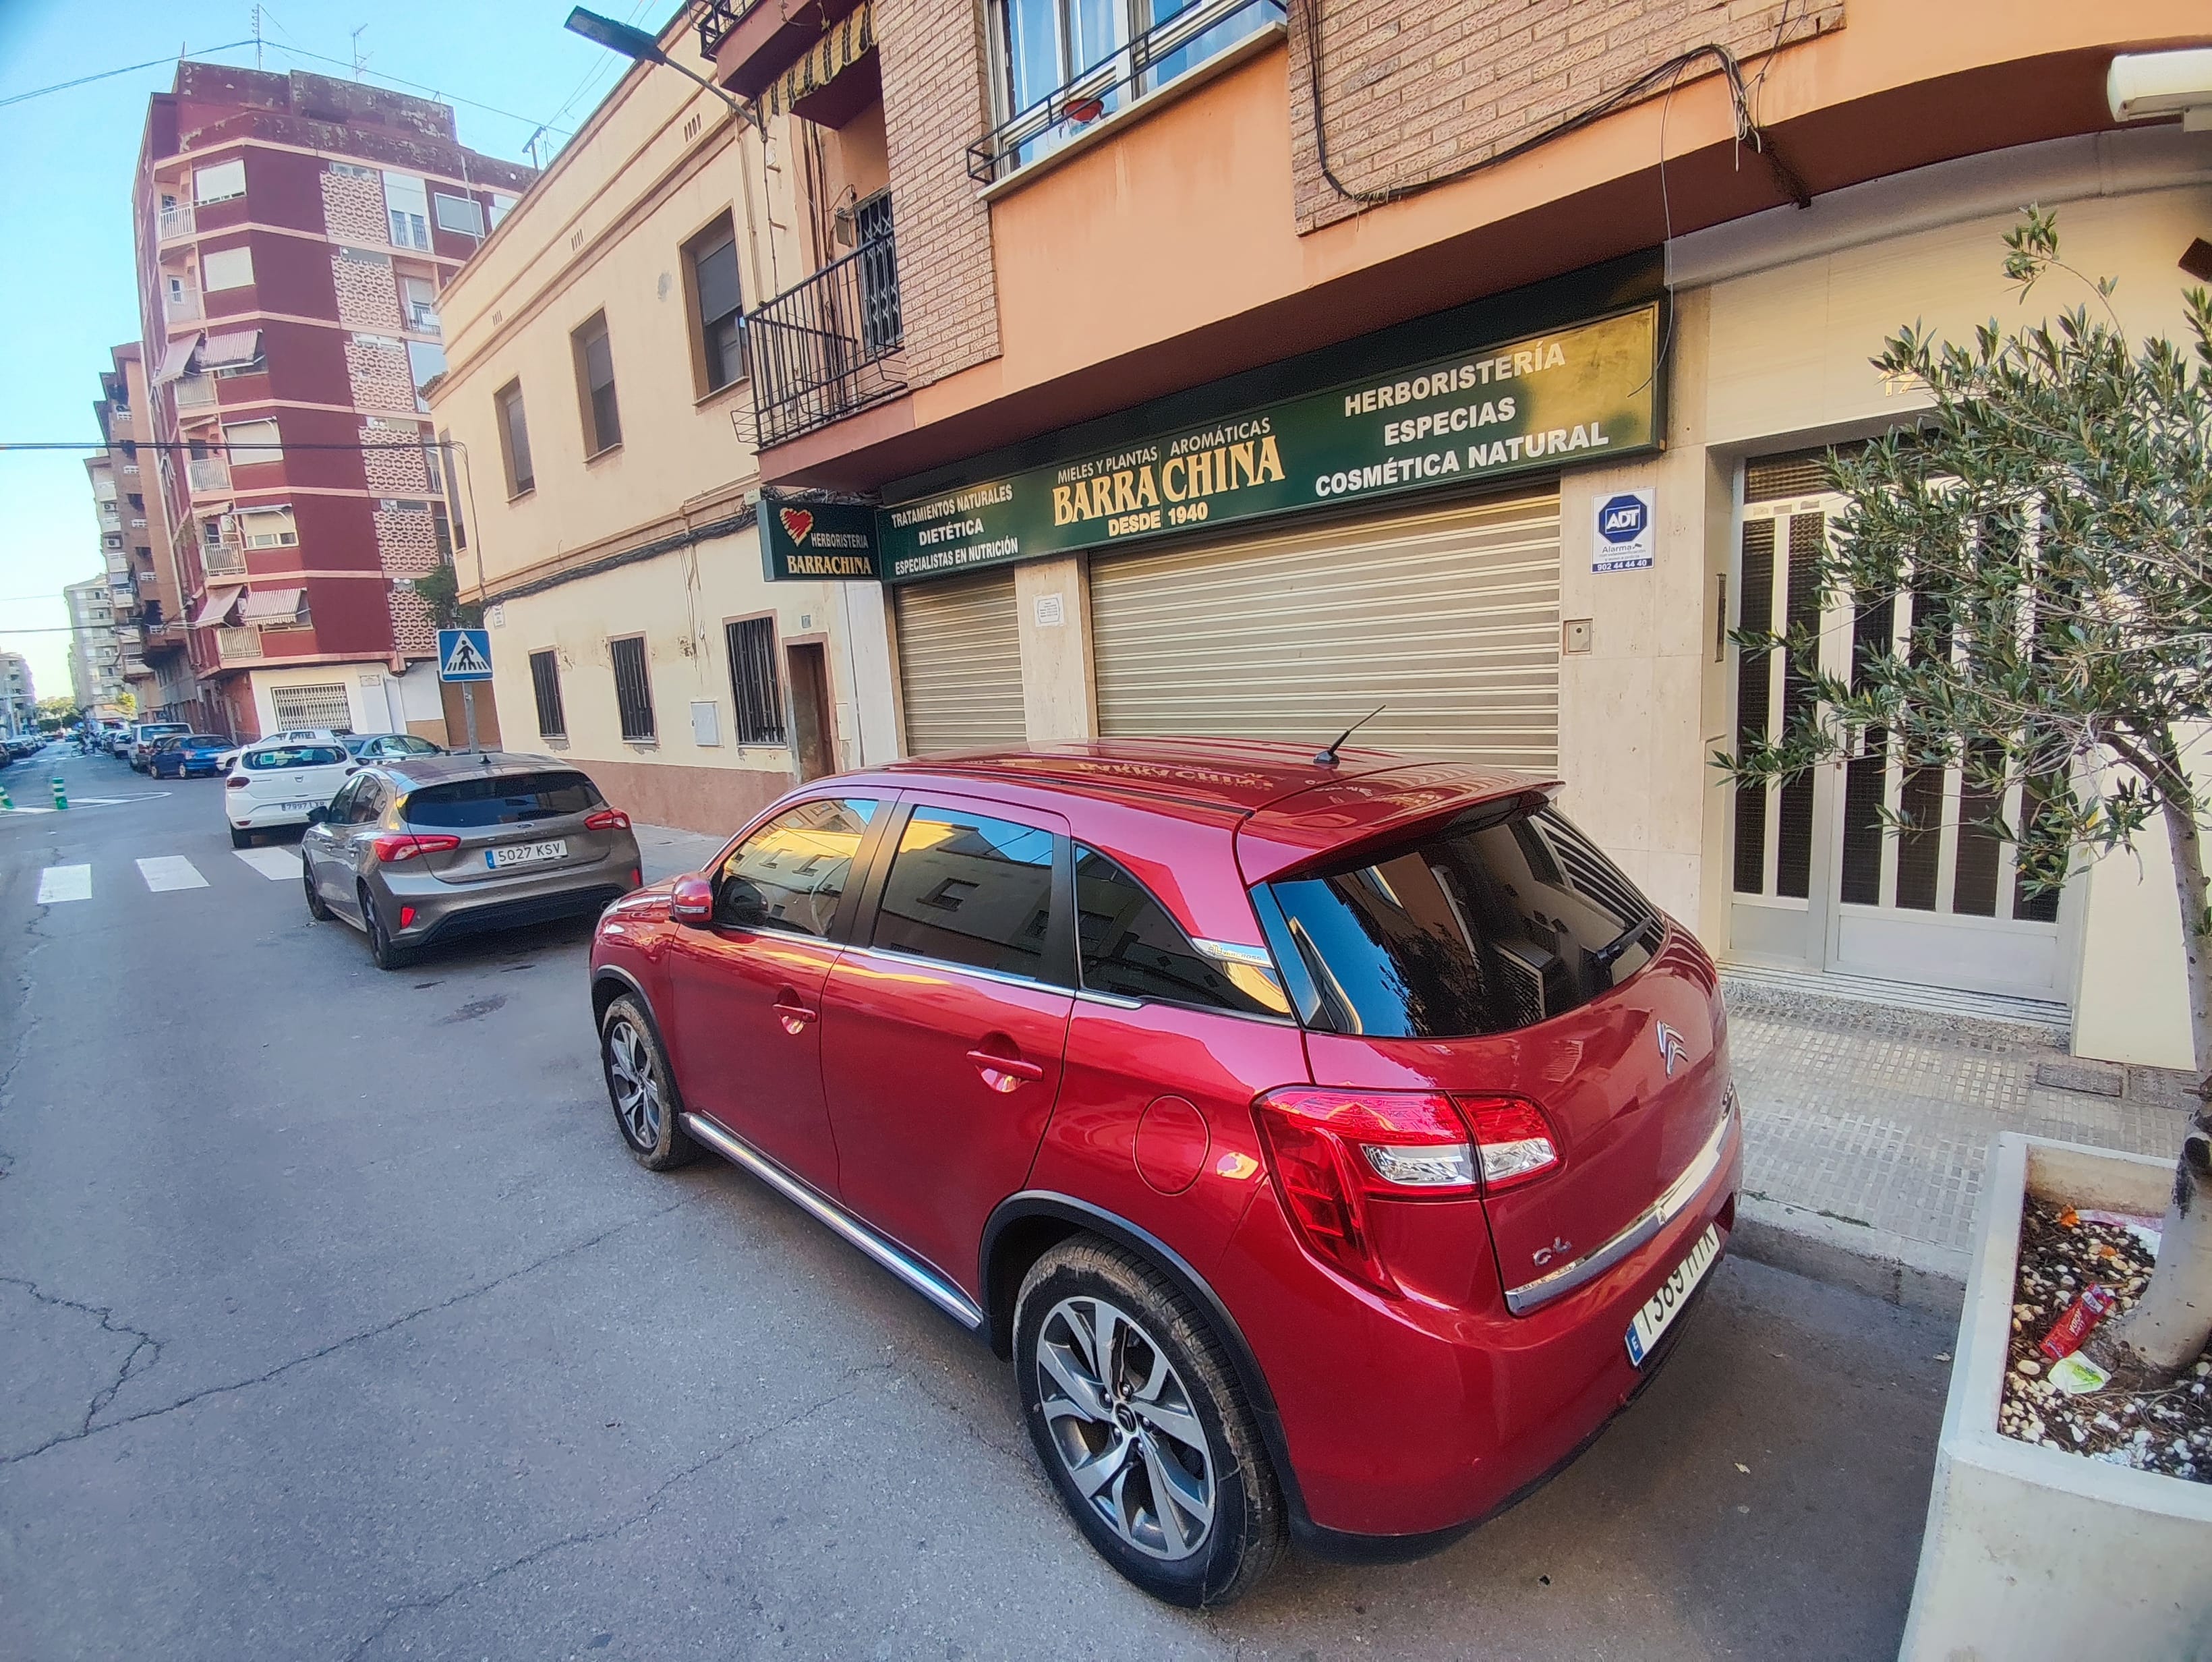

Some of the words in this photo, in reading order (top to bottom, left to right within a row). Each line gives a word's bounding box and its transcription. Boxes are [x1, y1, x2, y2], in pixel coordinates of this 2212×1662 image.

[1345, 341, 1566, 418] HERBORISTERÍA
[1384, 397, 1516, 447] ESPECIAS
[1057, 461, 1094, 484] MIELES
[1096, 461, 1103, 474] Y
[1106, 445, 1158, 471] PLANTAS
[1169, 417, 1271, 457] AROMÁTICAS
[1315, 450, 1460, 497] COSMÉTICA
[1468, 422, 1609, 469] NATURAL
[892, 498, 955, 528] TRATAMIENTOS
[956, 484, 1013, 513] NATURALES
[1108, 510, 1161, 537] DESDE
[1167, 501, 1209, 525] 1940
[1606, 509, 1640, 529] ADT
[811, 532, 869, 548] HERBORISTERIA
[919, 518, 985, 546] DIETÉTICA
[786, 555, 873, 575] BARRACHINA
[895, 550, 954, 575] ESPECIALISTAS
[955, 548, 966, 564] EN
[968, 535, 1018, 561] NUTRICIÓN
[1602, 545, 1632, 553] Alarma
[1597, 563, 1612, 571] 902
[498, 847, 531, 862] 5027
[536, 842, 560, 857] KSV
